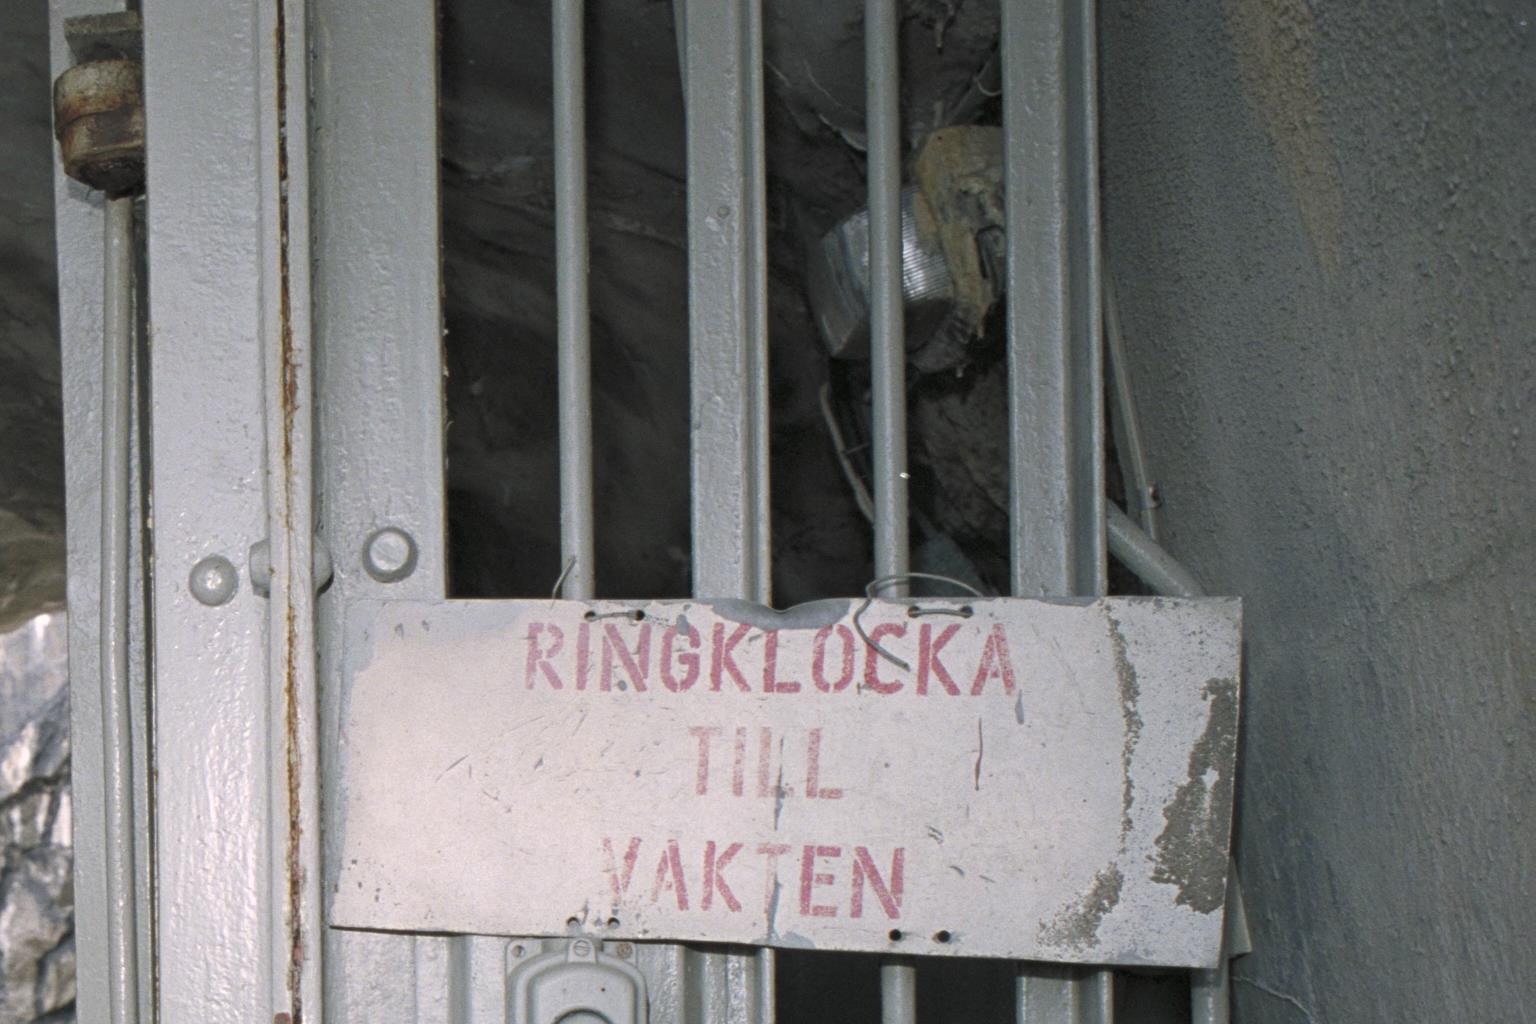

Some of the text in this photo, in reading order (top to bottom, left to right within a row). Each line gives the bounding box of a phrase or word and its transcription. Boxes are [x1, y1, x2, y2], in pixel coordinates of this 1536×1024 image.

[525, 621, 1016, 696] RINGKLOCKA
[689, 726, 843, 799] TILL
[602, 838, 906, 919] VAKTEN
